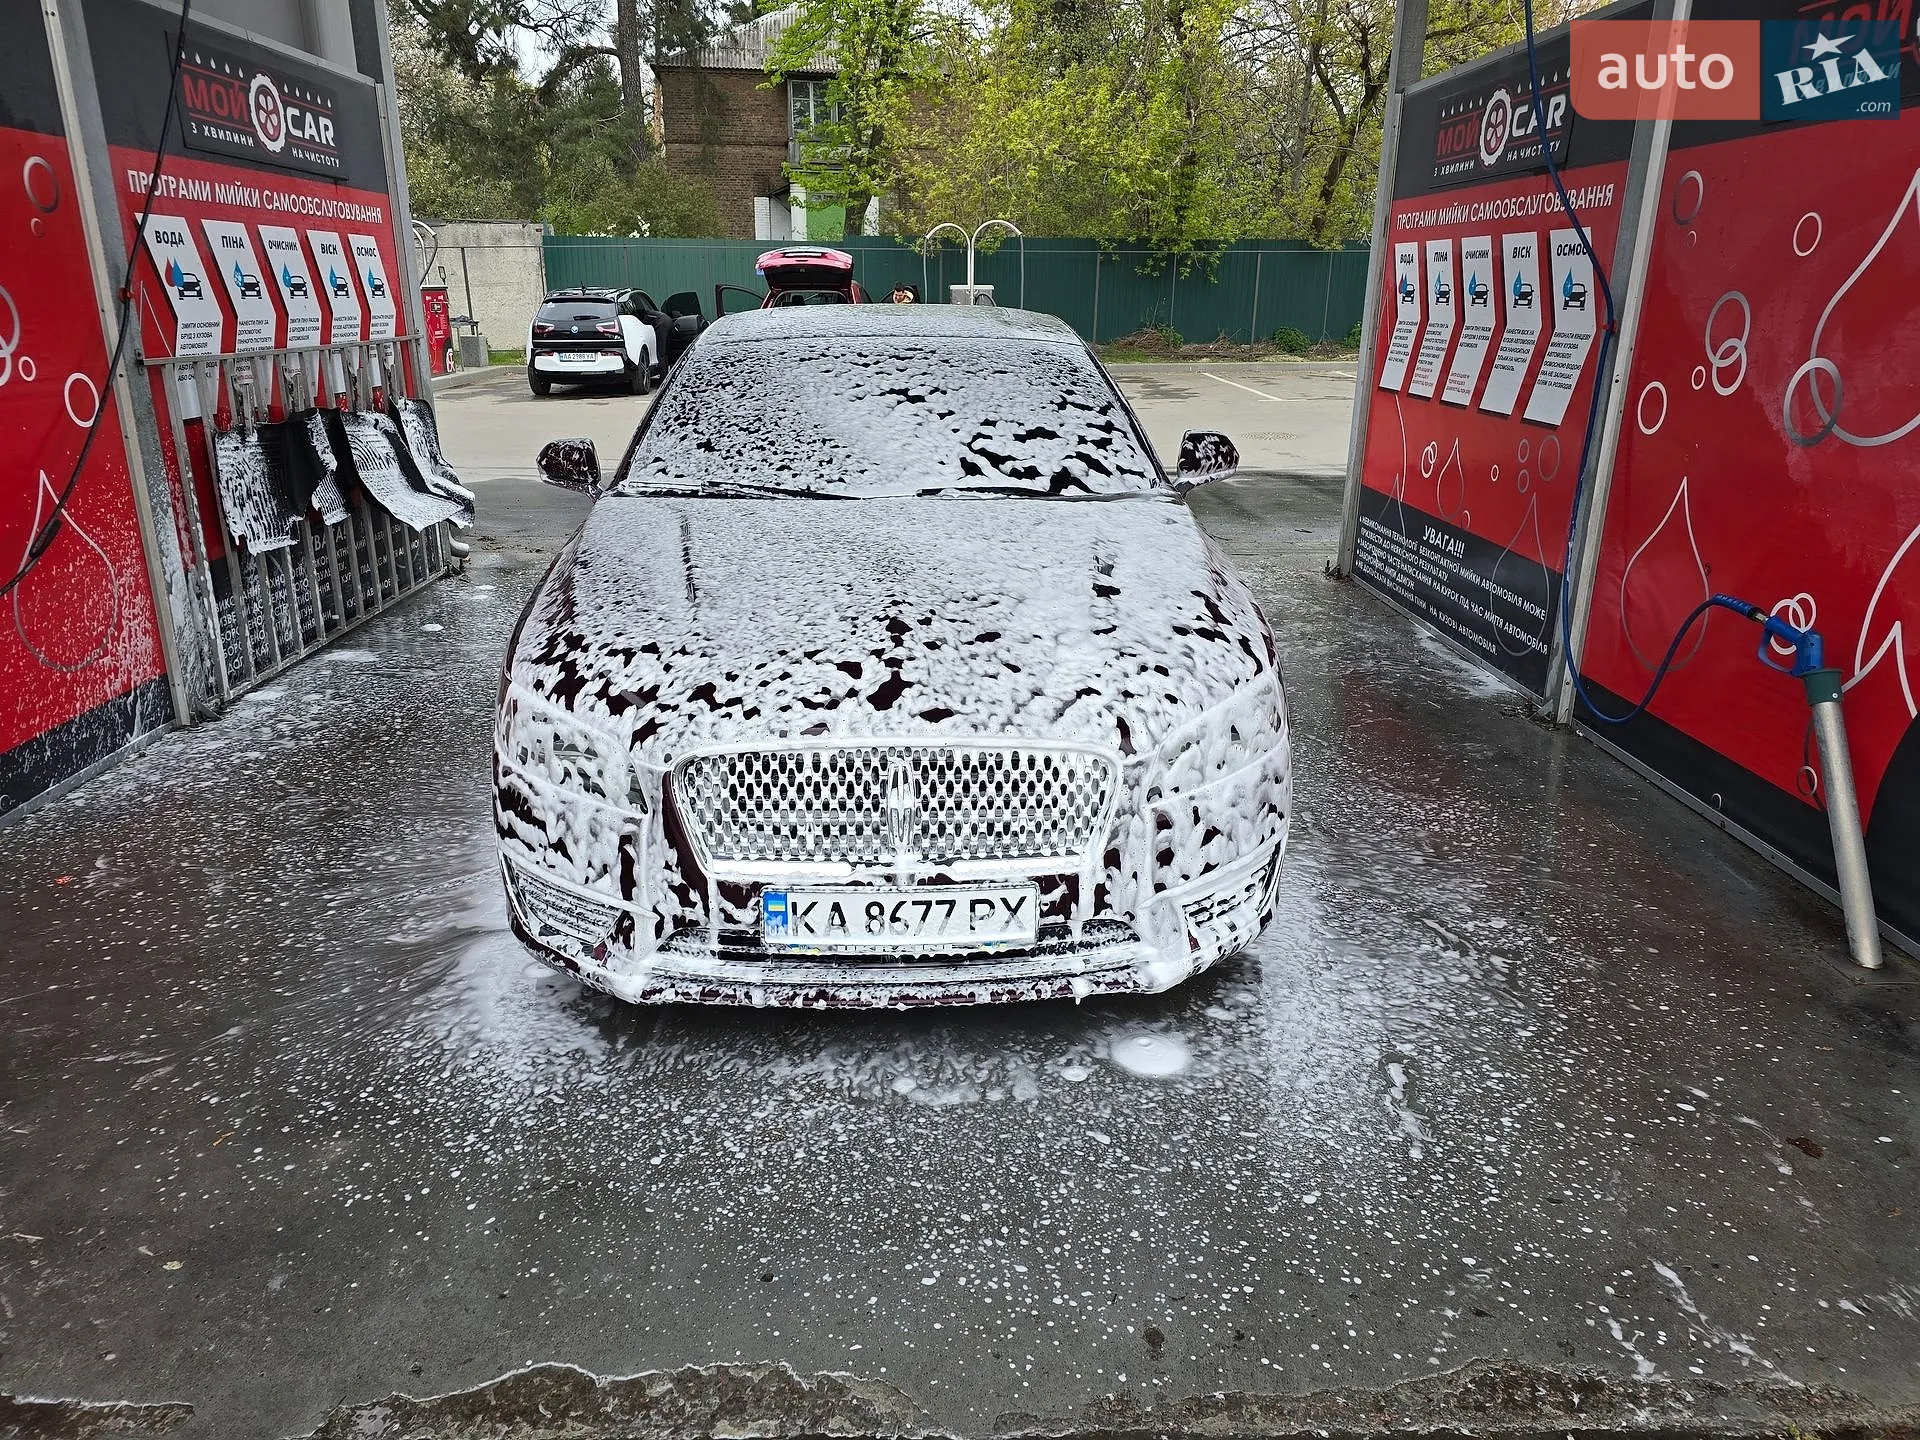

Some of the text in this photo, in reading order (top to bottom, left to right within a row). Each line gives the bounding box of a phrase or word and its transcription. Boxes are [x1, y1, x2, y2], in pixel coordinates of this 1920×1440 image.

[181, 74, 249, 123] МОЙ
[203, 124, 254, 147] ХВИЛИНИ
[286, 106, 336, 147] CAR
[1436, 114, 1480, 155] МОЙ
[292, 147, 340, 168] НА ЧИСТОТУ
[1507, 140, 1560, 162] НА ЧИСТТУ
[1440, 160, 1474, 175] ХВИЛИНИ
[215, 180, 260, 209] МИЙКИ
[263, 190, 382, 223] САМООБСЛУГОВУВАННЯ
[1396, 208, 1437, 230] ПРОГРАМИ
[1438, 202, 1469, 226] МИЙКИ
[154, 230, 184, 248] ВОДА
[221, 236, 245, 249] ПІНА
[268, 240, 298, 251] ОЧИСНИК
[320, 244, 338, 254] ВІСК
[356, 246, 376, 257] ОСМОС
[1400, 254, 1414, 265] ВОДА
[1434, 252, 1448, 262] ПІНА
[1465, 250, 1490, 260] ОЧИСНИК
[1512, 246, 1532, 258] ВІСК
[1423, 525, 1464, 558] УВАГА!!!
[1420, 545, 1460, 574] БЕЗКОНТАКТНОЇ
[1460, 566, 1480, 586] МИЙКИ
[1480, 578, 1522, 608] АВТОМОБІЛЯ
[1522, 600, 1546, 620] МОЖЕ
[1430, 605, 1438, 616] НА
[1438, 610, 1458, 630] КУЗОВІ
[1440, 585, 1458, 602] КУРОК
[1460, 596, 1469, 610] ПІД
[1470, 602, 1484, 616] ЧАС
[1484, 610, 1504, 628] МИТТЯ
[1504, 622, 1548, 655] АВТОМОБІЛЯ
[792, 896, 1028, 936] KA 8677 PX
